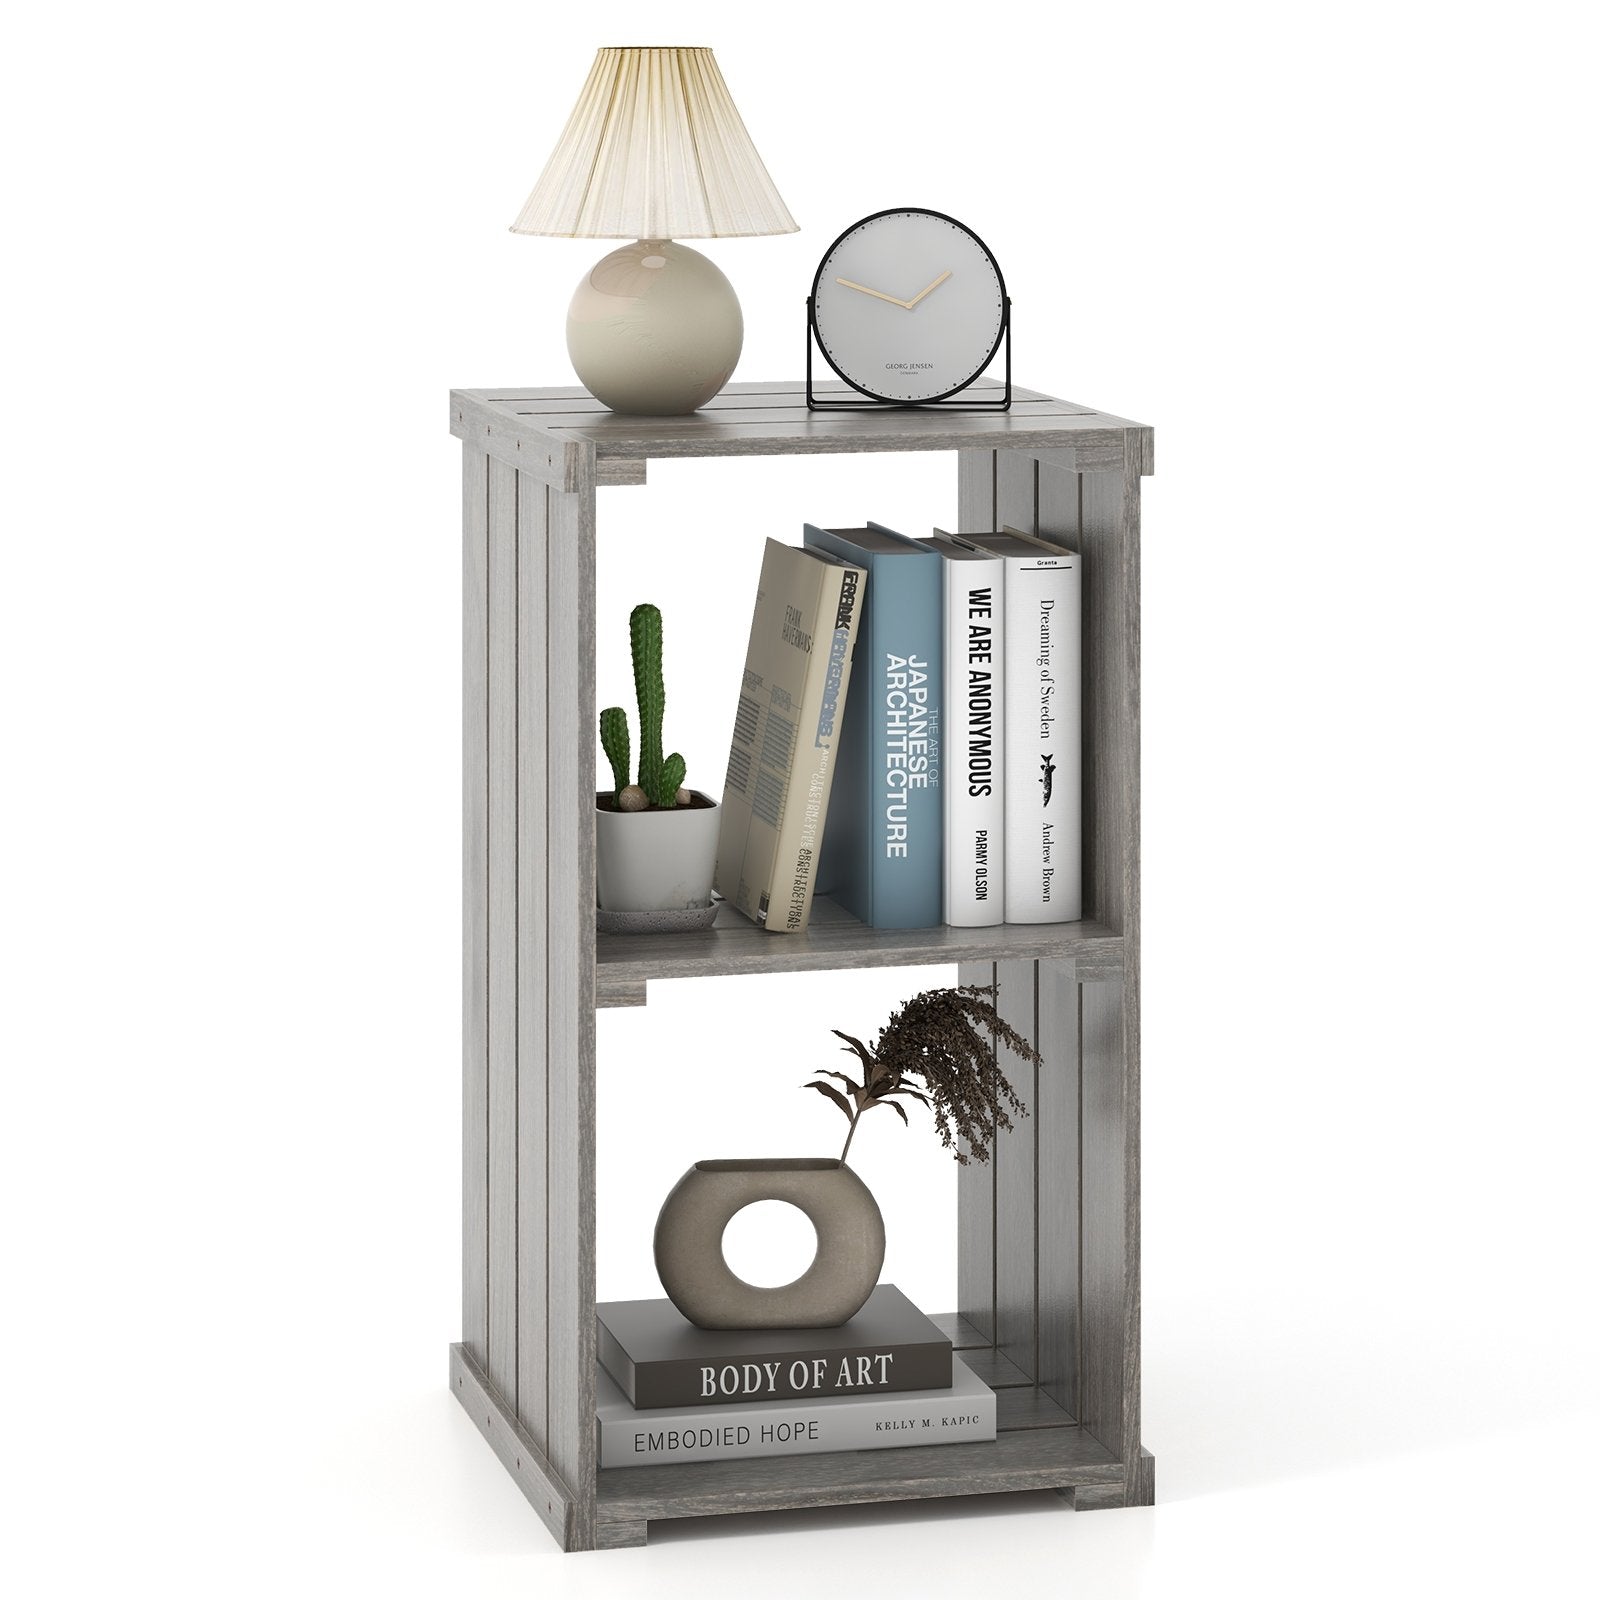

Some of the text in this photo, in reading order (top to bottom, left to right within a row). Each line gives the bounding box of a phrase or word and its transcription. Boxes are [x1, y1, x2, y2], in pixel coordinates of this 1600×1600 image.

[784, 604, 802, 627] FRANK
[968, 587, 992, 798] WE ARE ANONYMOUS
[1036, 600, 1055, 740] Dreaming of Sweden
[886, 653, 908, 858] ARCHITECTURE
[908, 654, 928, 789] JAPANESE
[928, 706, 938, 788] THE ART OF
[786, 848, 807, 929] CONSTRUCTIONS
[793, 848, 813, 930] ARCHITECTURAL
[975, 830, 988, 902] PARMY OLSON
[1042, 822, 1055, 903] Andrew Brown
[700, 1353, 894, 1397] BODY OF ART
[634, 1420, 820, 1453] EMBODIED HOPE
[875, 1414, 980, 1432] KELLY M. KAPIC
